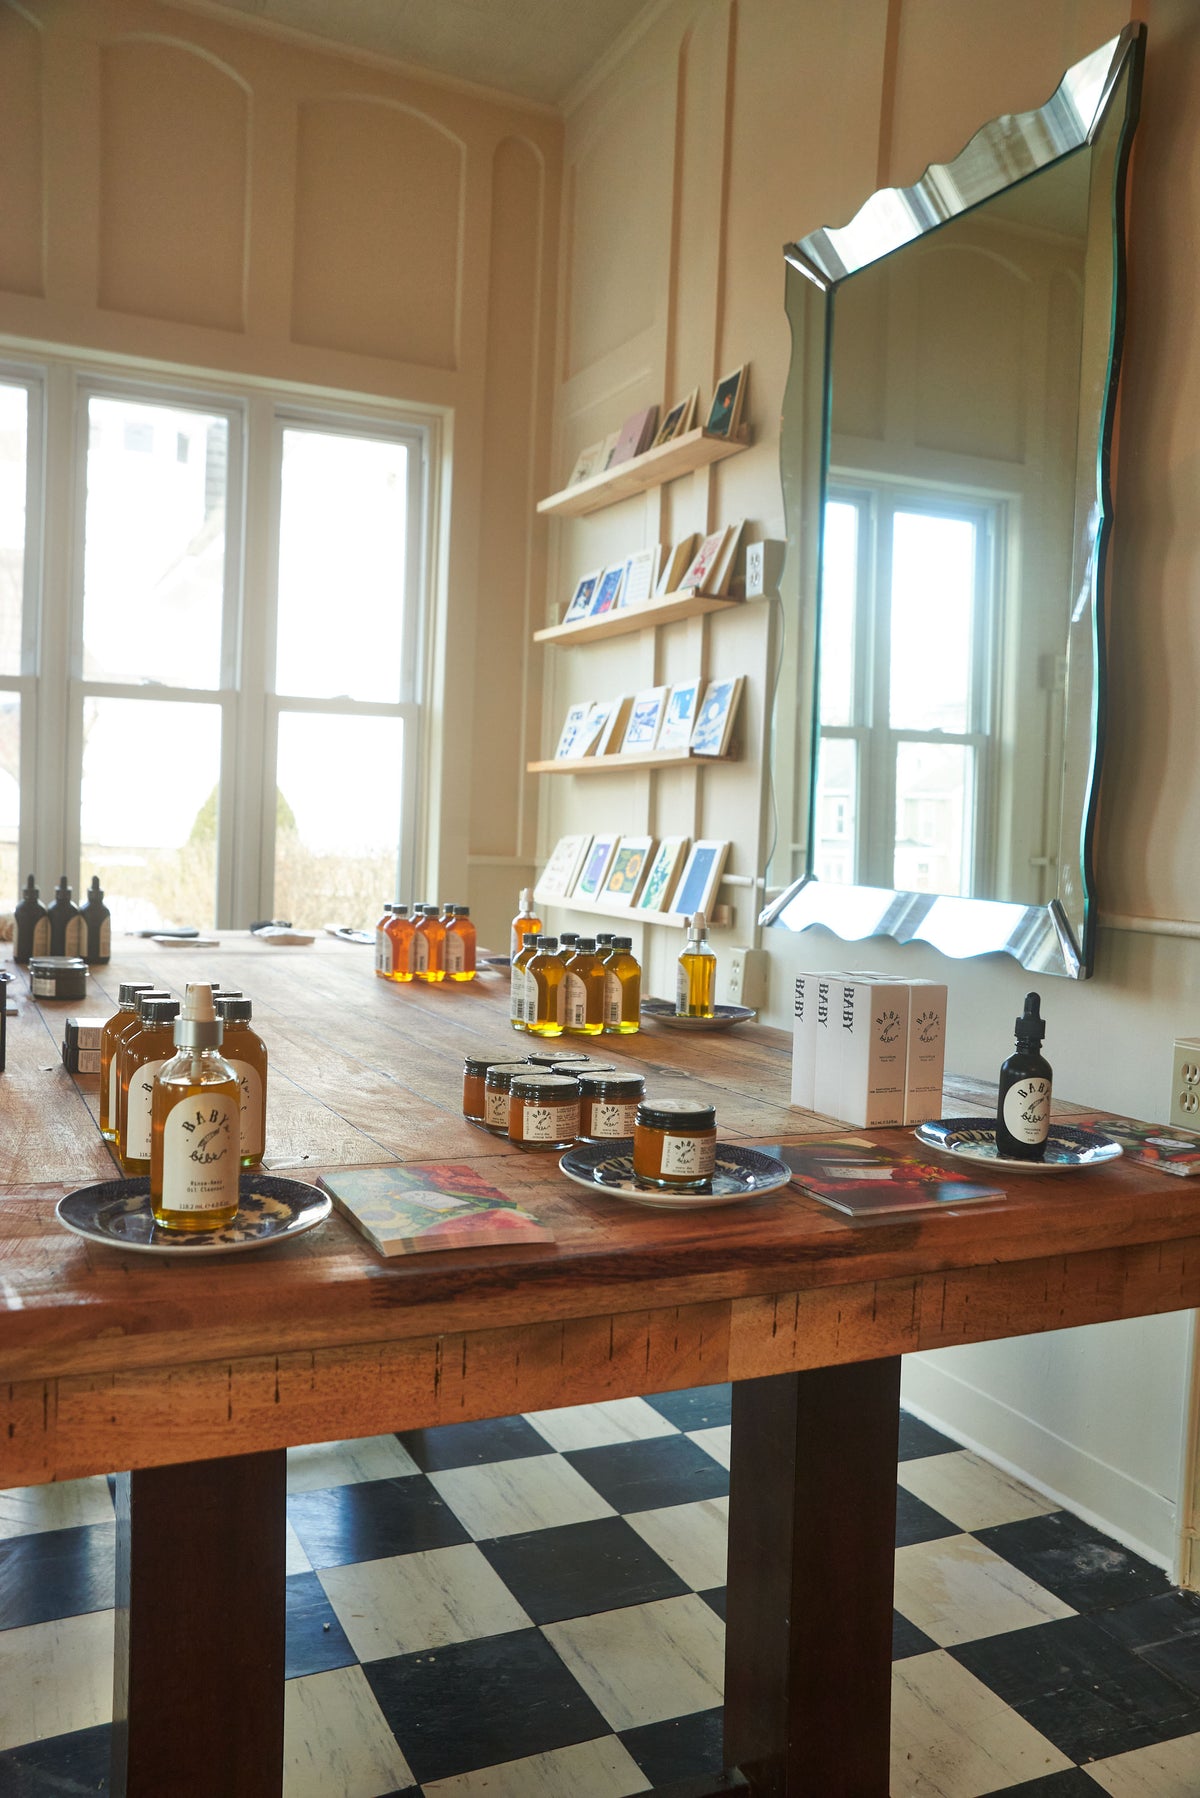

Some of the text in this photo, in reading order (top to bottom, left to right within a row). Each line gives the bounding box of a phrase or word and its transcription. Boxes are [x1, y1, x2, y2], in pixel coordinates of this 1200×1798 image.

[795, 978, 805, 1022] BABY
[818, 983, 829, 1028] BABY
[843, 987, 855, 1034] BABY
[876, 1011, 900, 1024] BABY
[916, 1011, 940, 1024] BABY
[182, 1109, 230, 1132] BABY
[674, 1140, 695, 1150] BABY
